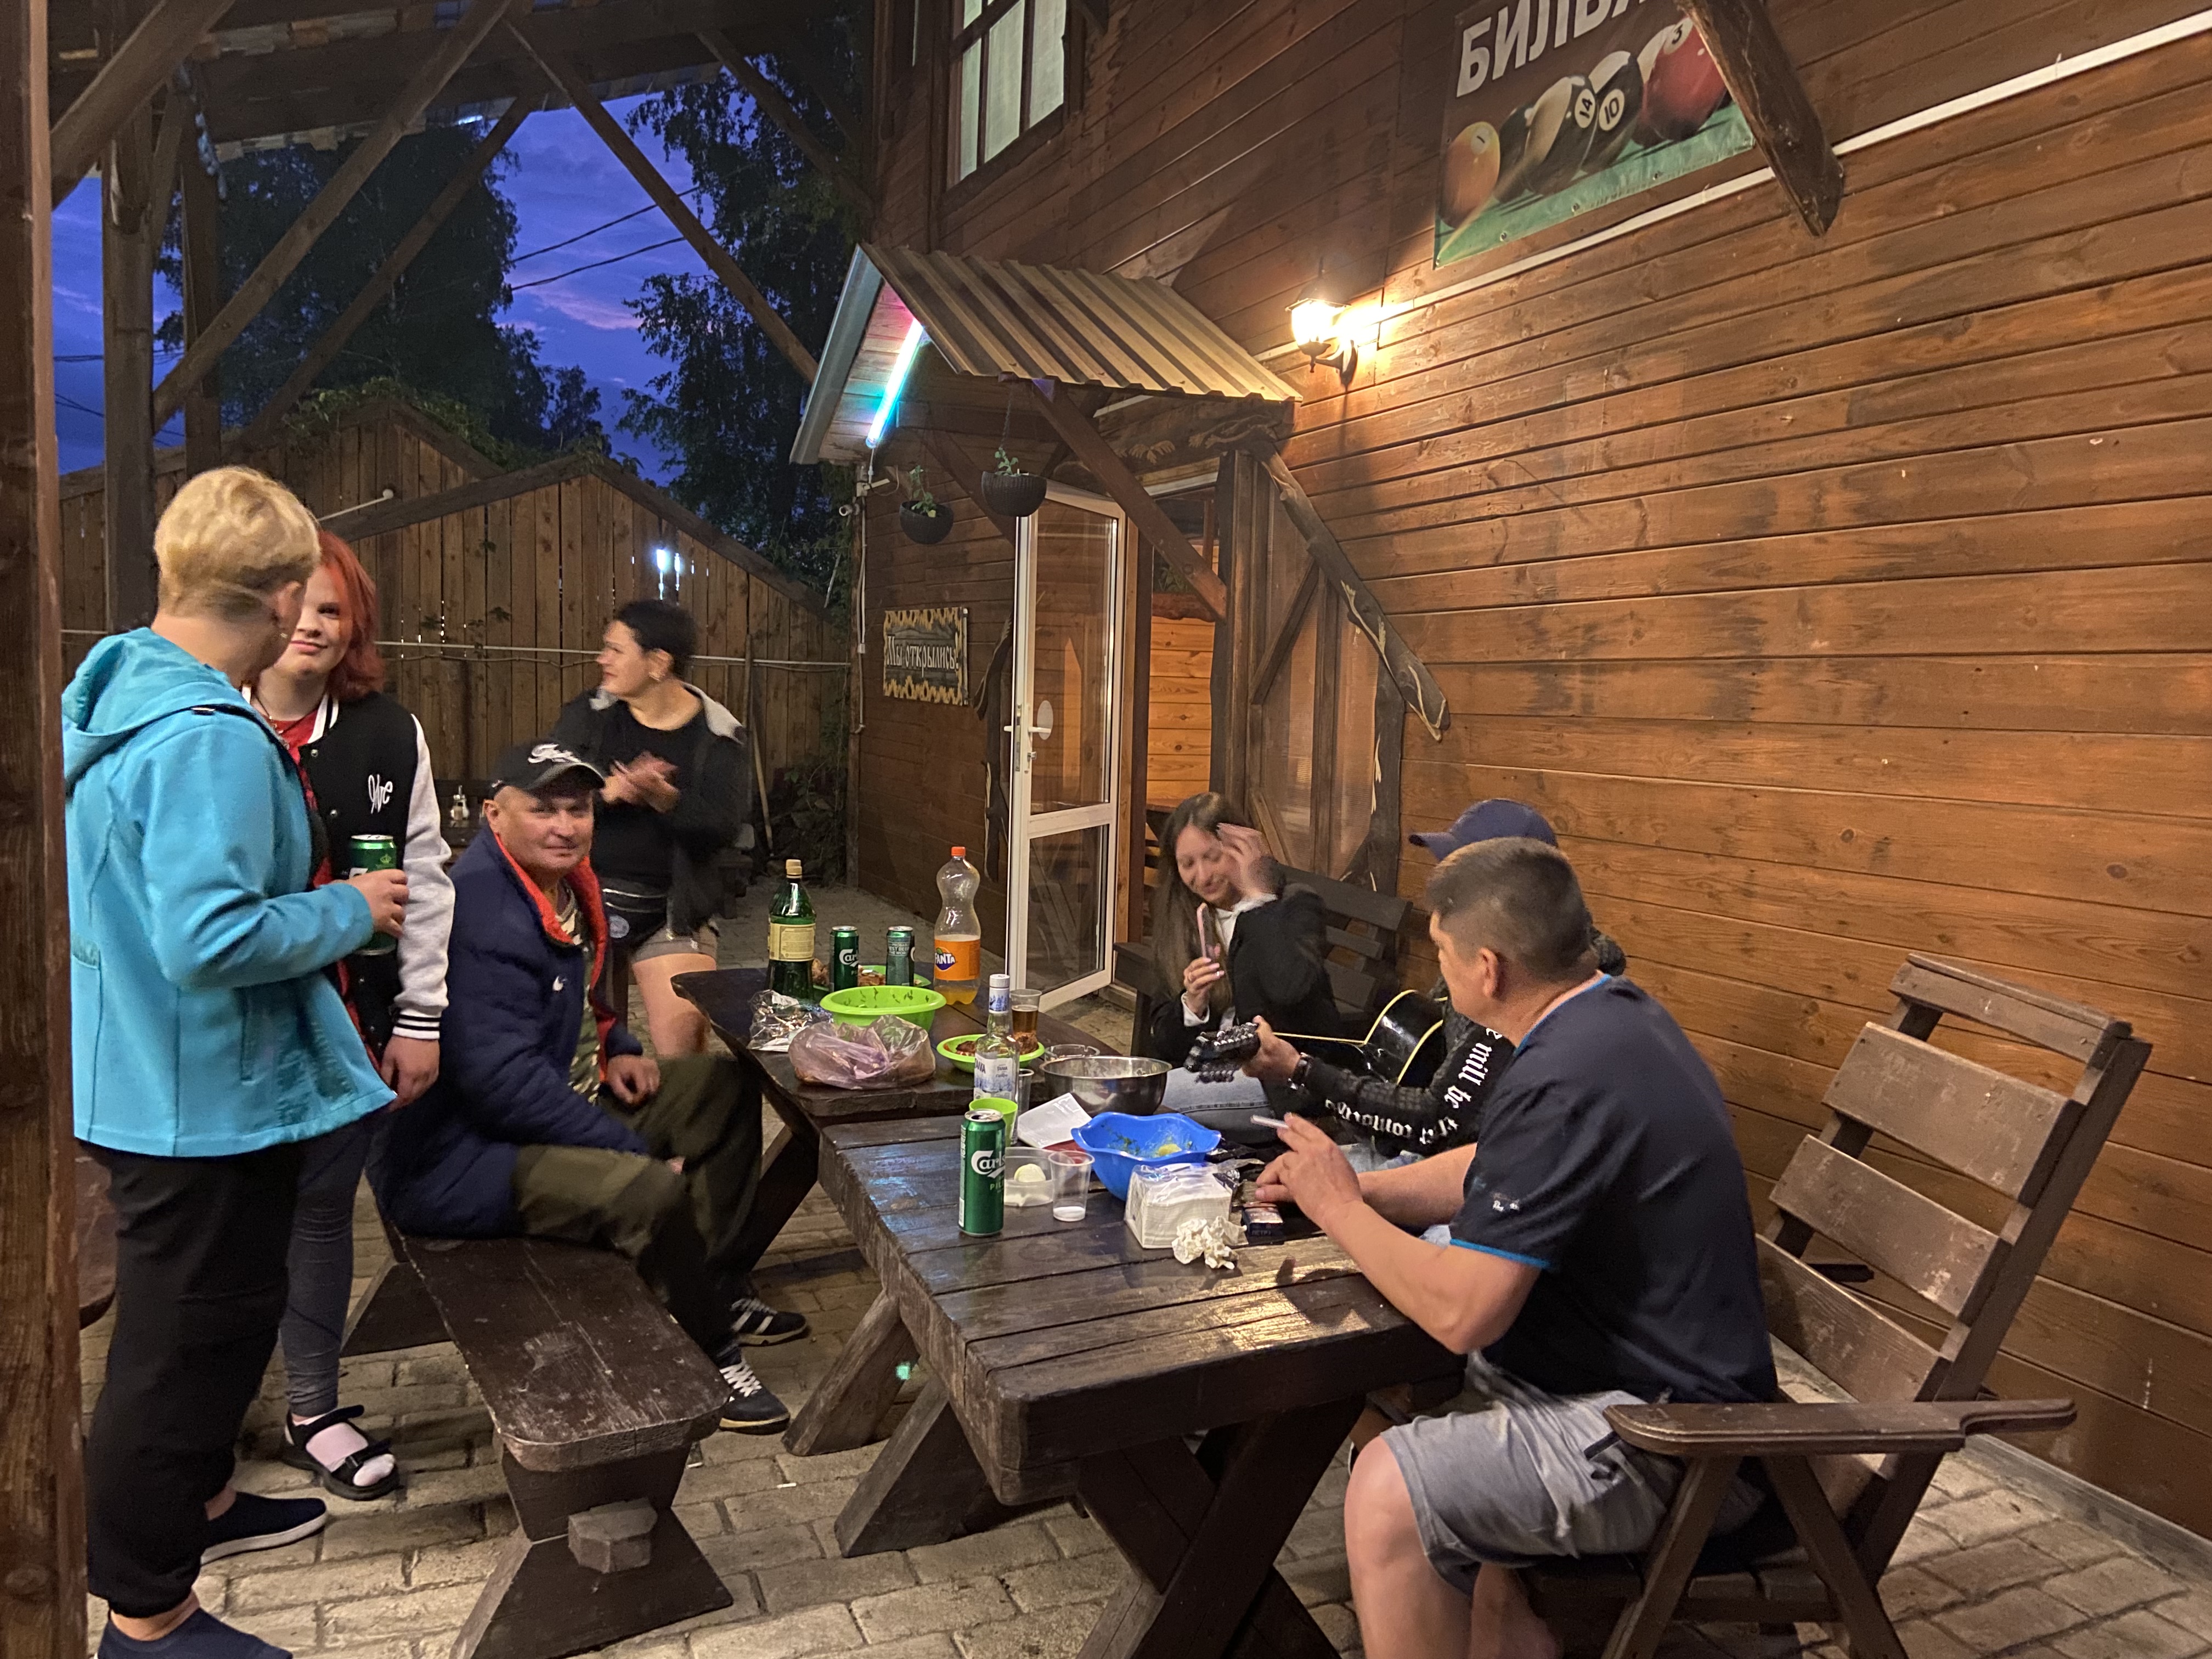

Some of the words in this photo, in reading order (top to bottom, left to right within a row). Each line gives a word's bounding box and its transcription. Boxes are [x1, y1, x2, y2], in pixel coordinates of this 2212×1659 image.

[1579, 98, 1593, 119] 14
[1604, 97, 1620, 125] 10
[887, 636, 902, 666] Мы
[905, 632, 959, 678] открылись!
